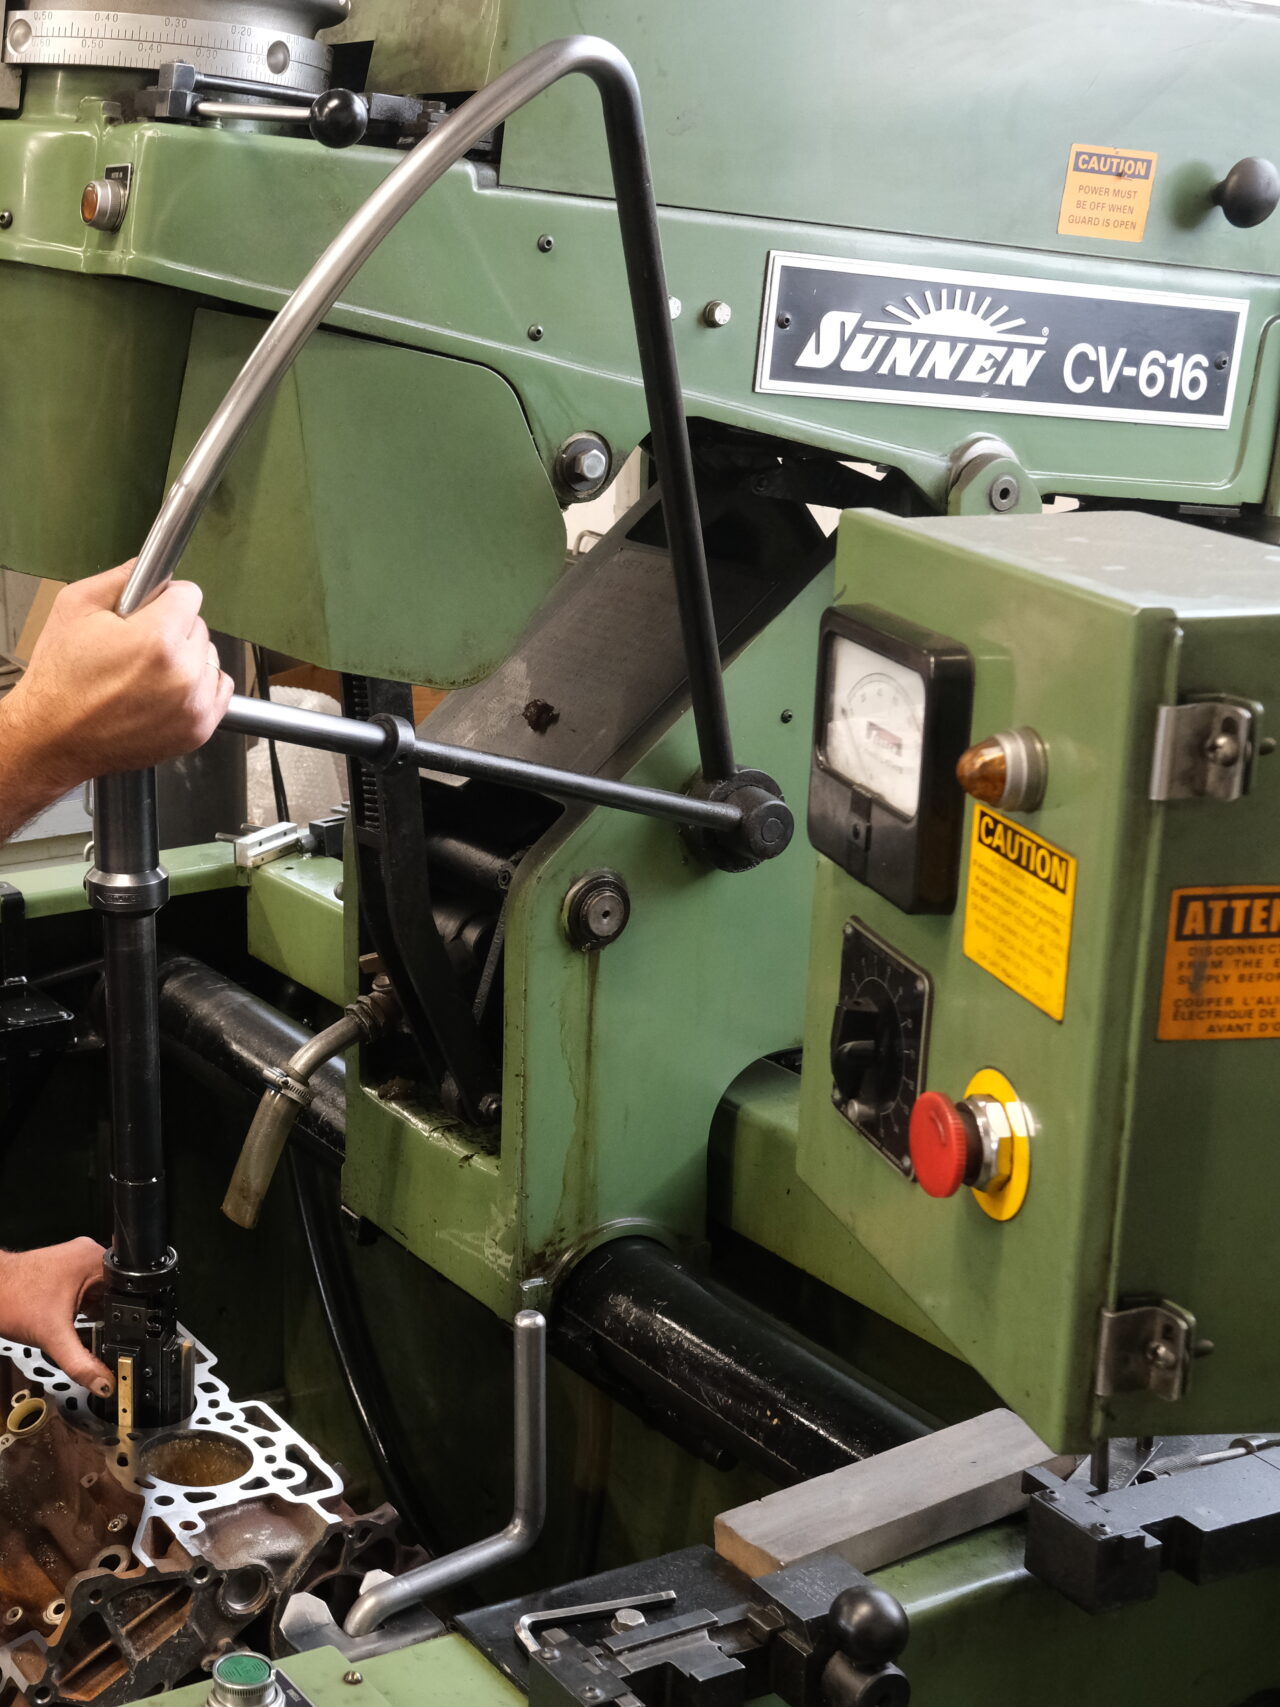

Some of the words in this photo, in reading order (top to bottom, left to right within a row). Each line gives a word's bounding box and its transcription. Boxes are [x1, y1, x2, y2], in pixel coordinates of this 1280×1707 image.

[33, 11, 53, 21] 0.50
[94, 13, 118, 22] 0.40
[165, 17, 187, 29] 0.30
[231, 25, 253, 36] 0.20
[81, 39, 104, 49] 0.50
[138, 43, 162, 53] 0.40
[196, 48, 218, 60] 0.30
[1078, 154, 1147, 176] CAUTION
[1078, 184, 1110, 197] POWER
[1112, 188, 1138, 200] MUST
[1075, 199, 1088, 210] BE
[1089, 201, 1107, 212] OFF
[1108, 203, 1135, 215] WHEN
[1067, 214, 1101, 227] GUARD
[1101, 218, 1111, 228] IS
[1112, 219, 1137, 231] OPEN
[794, 310, 1048, 388] SUNNEN
[1062, 342, 1209, 401] CV-616
[980, 815, 1067, 890] CAUTION
[1234, 958, 1263, 969] THE
[1173, 997, 1233, 1009] COUPER
[1258, 1008, 1277, 1018] DE
[1206, 1022, 1252, 1033] AVANT
